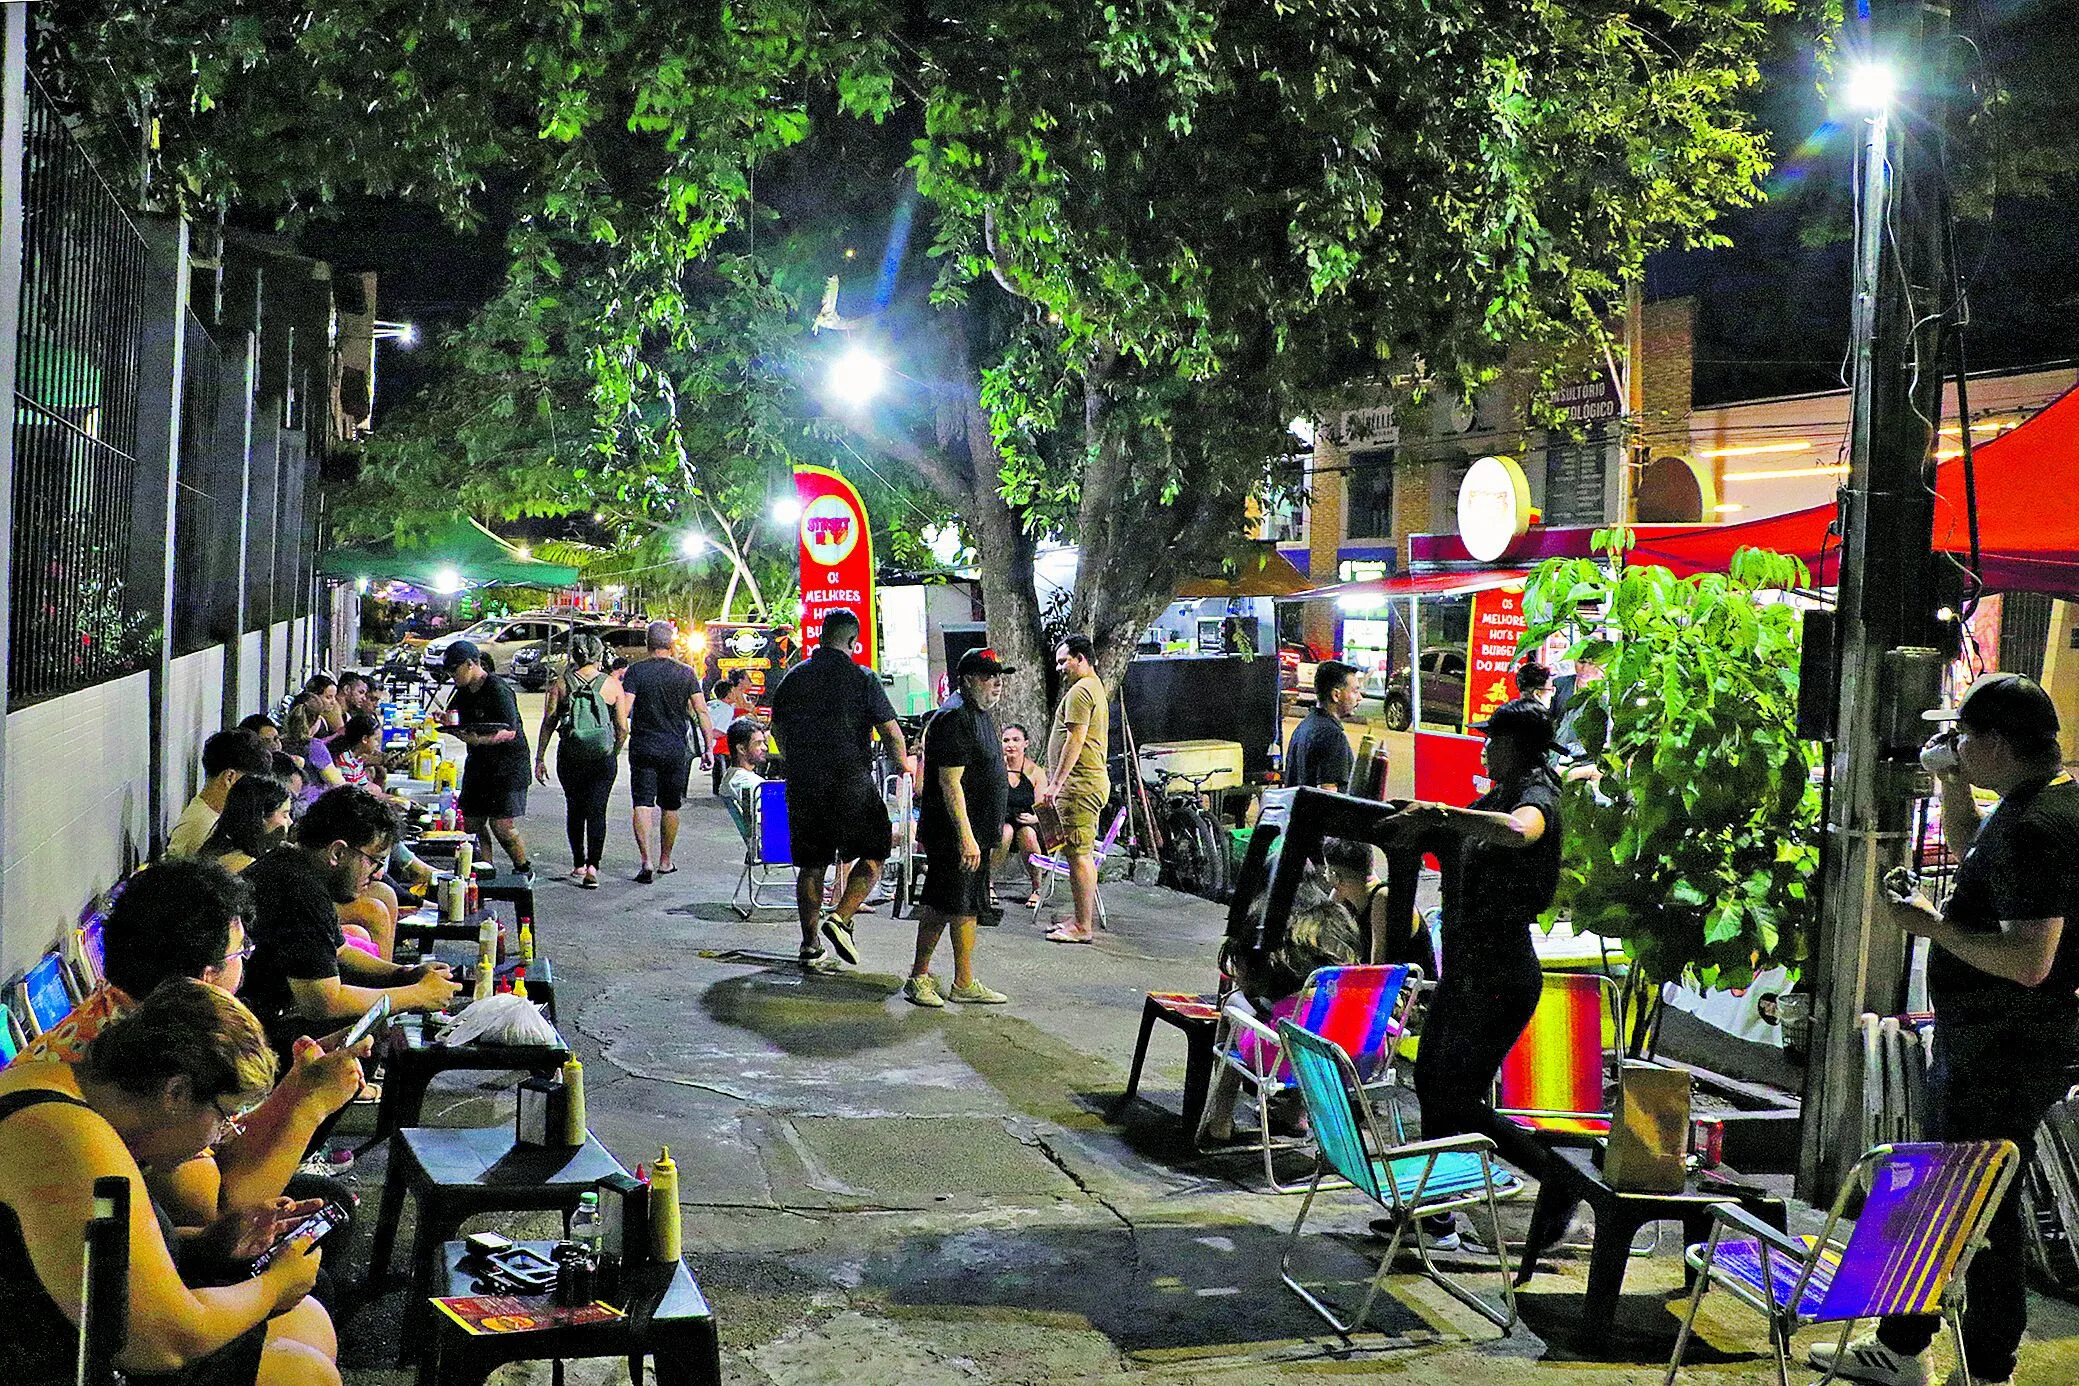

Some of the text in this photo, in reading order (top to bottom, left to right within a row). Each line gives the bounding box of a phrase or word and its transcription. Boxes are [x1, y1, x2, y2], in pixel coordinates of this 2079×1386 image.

[1501, 598, 1514, 610] OS
[1481, 613, 1527, 627] MELHORE
[1481, 644, 1516, 657] BURGE
[1476, 659, 1526, 674] DO MUD
